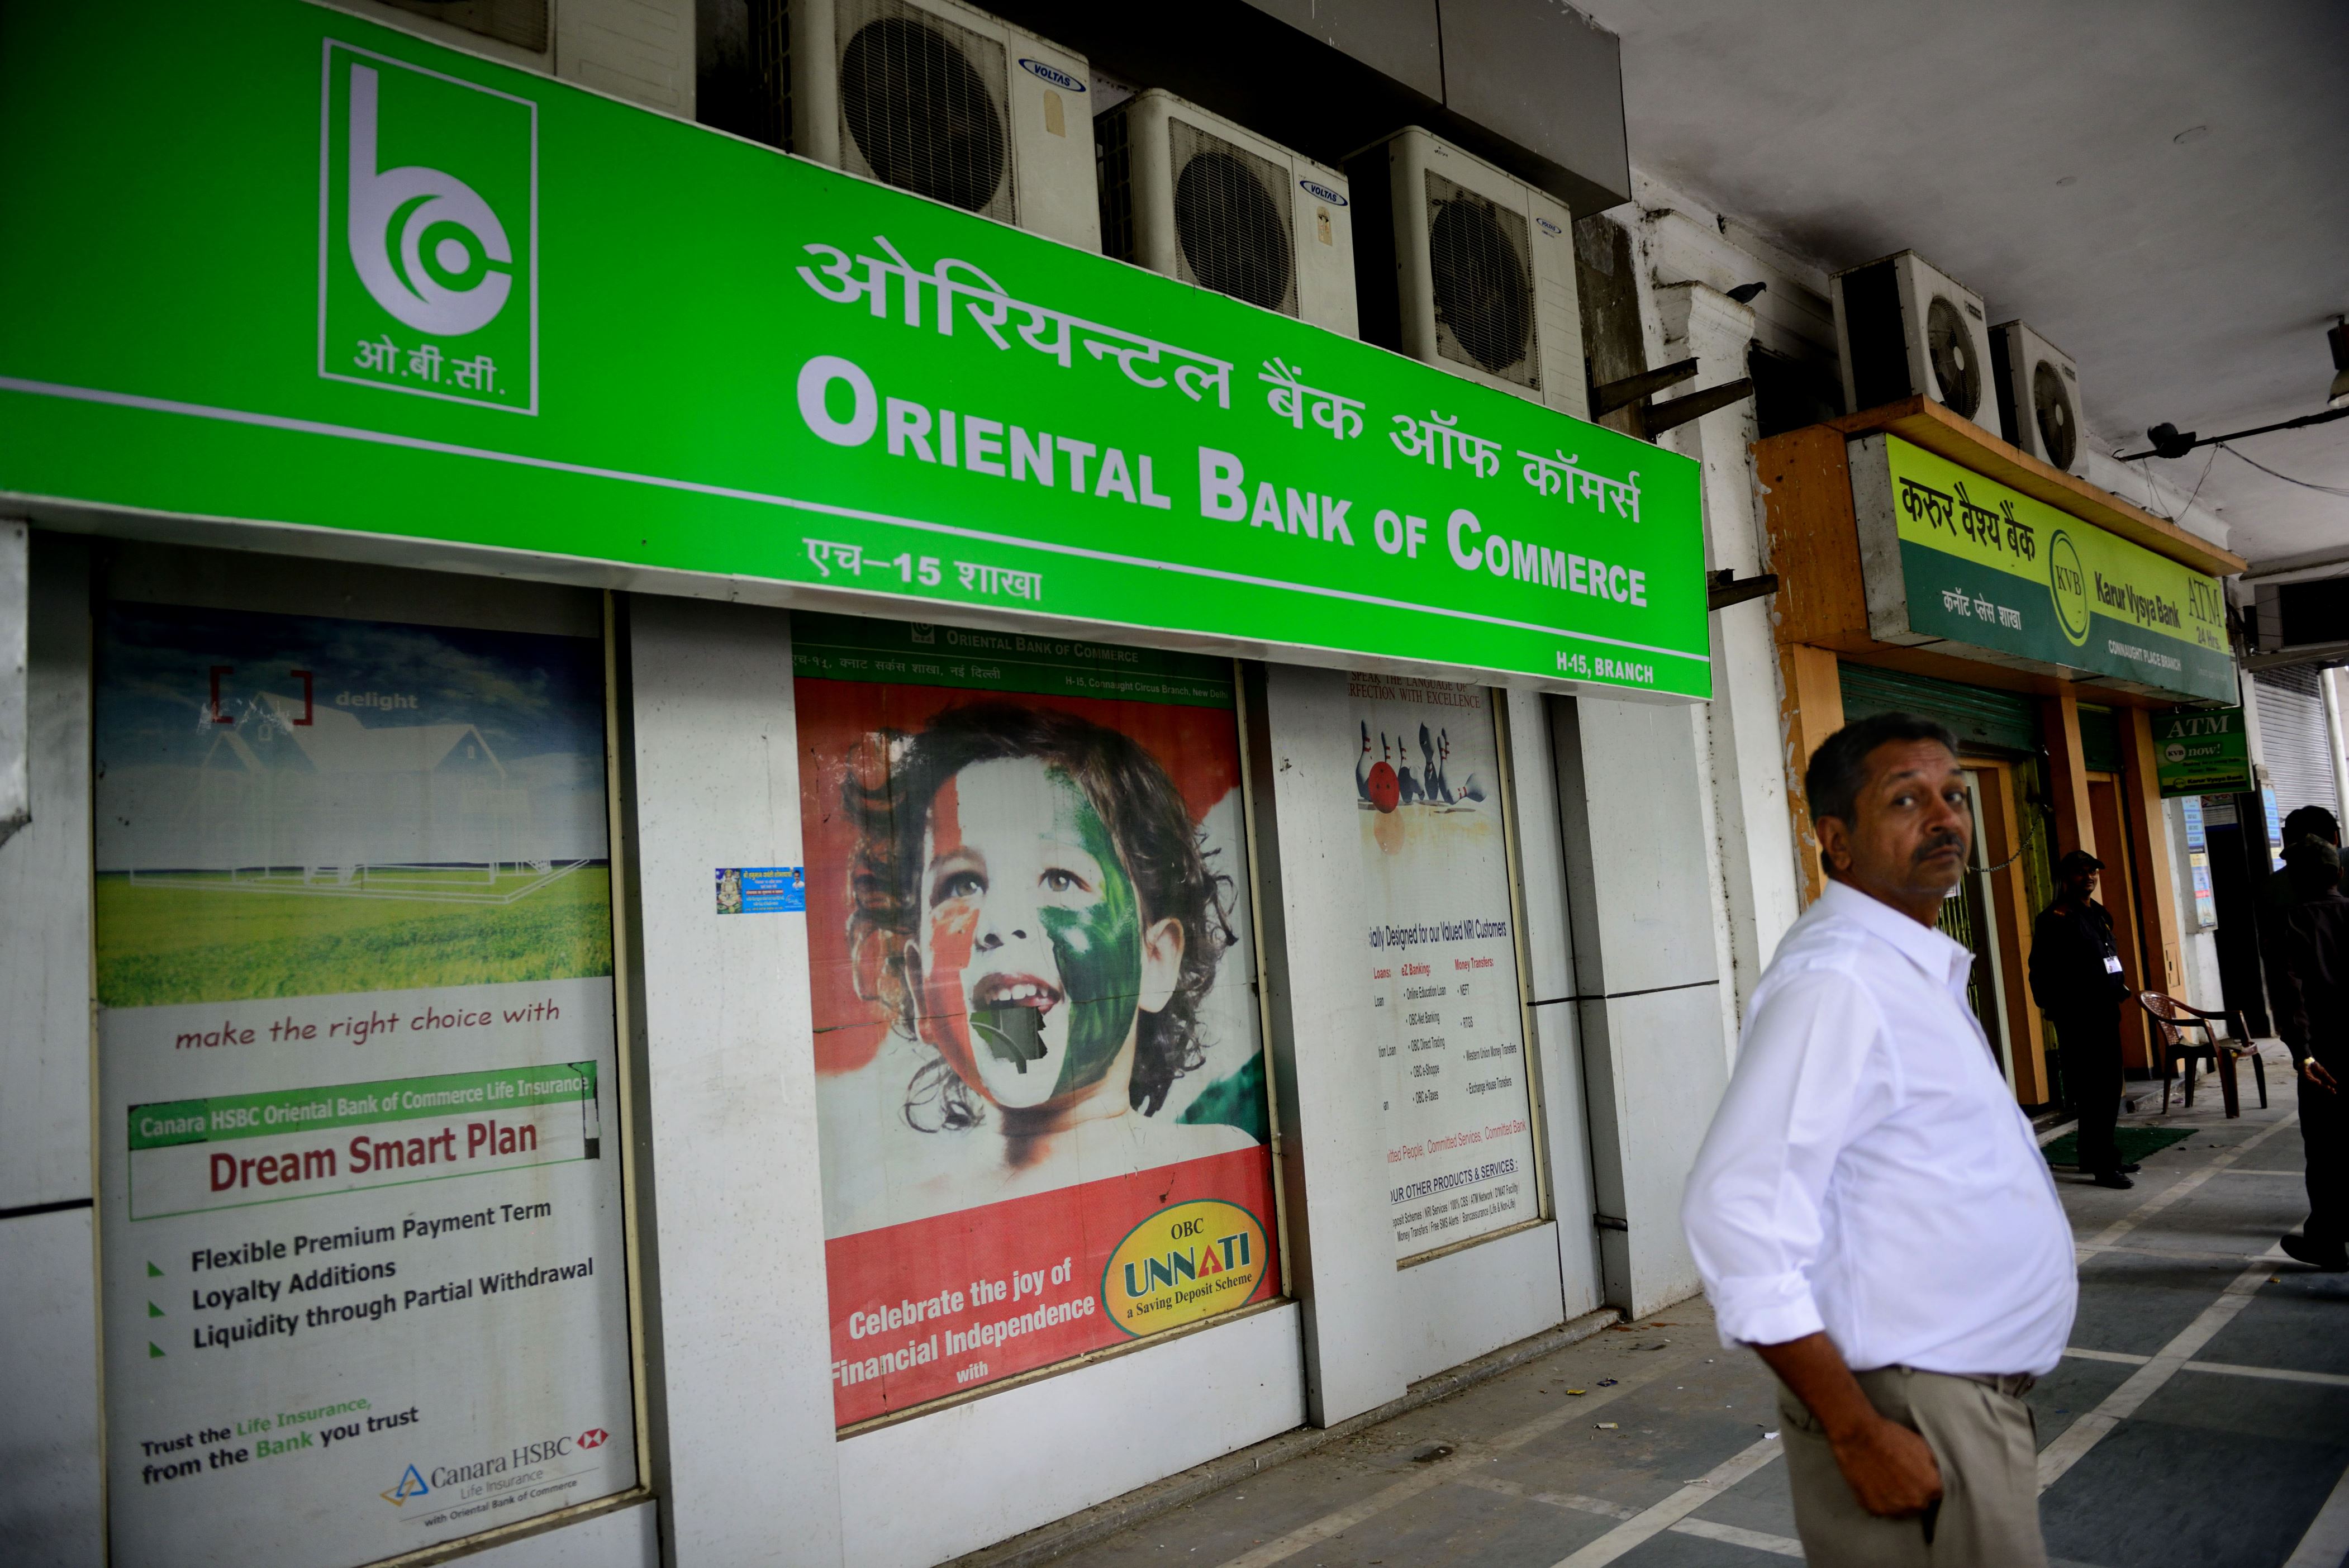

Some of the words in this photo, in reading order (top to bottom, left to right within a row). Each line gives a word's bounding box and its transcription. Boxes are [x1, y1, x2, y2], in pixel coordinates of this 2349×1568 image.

[1035, 64, 1071, 86] VOLTAS
[1311, 185, 1337, 202] VOLTAS
[795, 235, 1234, 409] ओरियन्टल
[1258, 356, 1366, 440] बैंक
[1389, 410, 1502, 478] ऑफ
[1516, 449, 1642, 523] कॉमर्स
[797, 355, 1171, 509] ORIENTAL
[1199, 445, 1354, 546] BANK
[1374, 509, 1427, 559] OF
[1447, 508, 1647, 607] COMMERCE
[1954, 481, 2002, 550] वैश्य
[1999, 500, 2035, 561] बैंक
[954, 560, 1042, 601] शाखा
[2055, 565, 2081, 596] KVB
[1942, 588, 1971, 616] कनॉट
[1974, 594, 1995, 624] प्लेस
[1998, 606, 2022, 630] शाखा
[2095, 571, 2125, 611] Karur
[2125, 584, 2156, 627] Vysya
[2156, 595, 2181, 629] Bank
[2188, 577, 2222, 628] ATM
[2196, 626, 2206, 644] 24
[2207, 630, 2222, 651] Hrs.
[1556, 651, 1592, 678] H-15,
[1595, 656, 1653, 683] BRANCH
[2108, 640, 2143, 662] CONNAUGHT
[2143, 648, 2161, 666] PLACE
[2161, 654, 2181, 671] BRANCH
[949, 664, 965, 678] नई
[971, 665, 1001, 680] दिल्ली
[1352, 672, 1381, 683] SPEAK
[1386, 674, 1402, 685] THE
[1406, 676, 1453, 691] LANGUAGE
[335, 691, 419, 710] delight
[1088, 678, 1133, 692] Connaught
[1135, 682, 1160, 693] Circus
[1162, 685, 1191, 697] Branch,
[1192, 688, 1208, 698] New
[1210, 690, 1228, 700] Delhi
[1400, 688, 1423, 703] WITH
[1427, 691, 1480, 708] EXCELLENCE
[2166, 715, 2230, 738] ATM
[2188, 743, 2220, 757] now!
[1386, 922, 1418, 951] Designed
[1419, 923, 1428, 943] for
[1429, 925, 1440, 943] our
[1440, 920, 1462, 941] Valued
[1463, 919, 1475, 940] NRI
[1475, 918, 1506, 939] Customers
[1373, 967, 1391, 979] Loans:
[1401, 964, 1409, 976] eZ
[1409, 963, 1430, 978] Banking:
[1455, 958, 1470, 972] Money
[1470, 956, 1494, 968] Transfers:
[1406, 988, 1419, 1000] Online
[1419, 986, 1437, 999] Education
[1437, 985, 1446, 996] Loan
[1460, 983, 1470, 996] NEFT
[175, 1021, 255, 1050] make
[269, 1015, 317, 1043] the
[329, 1010, 400, 1046] right
[410, 1005, 493, 1032] choice
[502, 998, 560, 1024] with
[1425, 1011, 1440, 1025] Banking
[1463, 1016, 1473, 1028] RTGS
[1466, 1049, 1480, 1062] Western
[1480, 1047, 1490, 1059] Union
[1490, 1046, 1501, 1058] Money
[1501, 1043, 1516, 1056] Transfers
[1469, 1082, 1486, 1095] Exchange
[1486, 1079, 1496, 1090] House
[1496, 1076, 1512, 1087] Transfers
[140, 1115, 206, 1139] Canara
[210, 1105, 261, 1130] HSBC
[264, 1098, 334, 1125] Oriental
[337, 1094, 378, 1118] Bank
[382, 1091, 400, 1111] of
[401, 1086, 483, 1109] Commerce
[486, 1080, 514, 1101] Life
[517, 1075, 590, 1098] Insurance
[210, 1147, 337, 1193] Dream
[348, 1128, 457, 1174] Smart
[467, 1119, 538, 1158] Plan
[1402, 1145, 1425, 1161] People,
[1428, 1135, 1457, 1154] Committed
[1458, 1130, 1482, 1147] Services,
[1485, 1124, 1513, 1140] Committed
[1513, 1119, 1527, 1134] Bank
[1406, 1180, 1432, 1198] OTHER
[1433, 1169, 1473, 1191] PRODUCTS
[1474, 1167, 1480, 1180] &
[1481, 1158, 1514, 1179] SERVICES
[192, 1239, 286, 1272] Flexible
[294, 1225, 395, 1256] Premium
[402, 1208, 496, 1239] Payment
[500, 1200, 552, 1223] Term
[1171, 1218, 1204, 1240] OBC
[1124, 1231, 1250, 1299] UNNATI
[193, 1279, 280, 1310] Loyalty
[288, 1260, 396, 1294] Additions
[849, 1289, 964, 1340] Celebrate
[969, 1277, 1007, 1308] the
[1010, 1270, 1044, 1300] joy
[1050, 1257, 1072, 1286] of
[1127, 1309, 1134, 1319] a
[1136, 1296, 1172, 1316] Saving
[1174, 1282, 1213, 1304] Deposit
[1215, 1273, 1252, 1292] Scheme
[194, 1314, 299, 1349] Liquidity
[306, 1295, 396, 1327] through
[404, 1279, 473, 1310] Partial
[478, 1258, 593, 1295] Withdrawal
[946, 1295, 1096, 1357] Independence
[956, 1360, 988, 1384] with
[141, 1437, 194, 1457] Trust
[199, 1425, 231, 1446] the
[236, 1417, 272, 1438] Life
[276, 1396, 373, 1429] Insurance,
[142, 1458, 202, 1485] from
[207, 1445, 249, 1470] the
[255, 1431, 313, 1459] Bank
[320, 1425, 360, 1448] you
[367, 1406, 420, 1432] trust
[431, 1456, 507, 1489] Canara
[512, 1436, 572, 1469] HSBC
[460, 1484, 483, 1500] Life
[486, 1470, 543, 1493] Insurance
[425, 1514, 446, 1527] with
[450, 1502, 489, 1520] Oriental
[492, 1496, 515, 1509] Bank
[518, 1491, 528, 1502] of
[530, 1480, 577, 1499] Commerce
